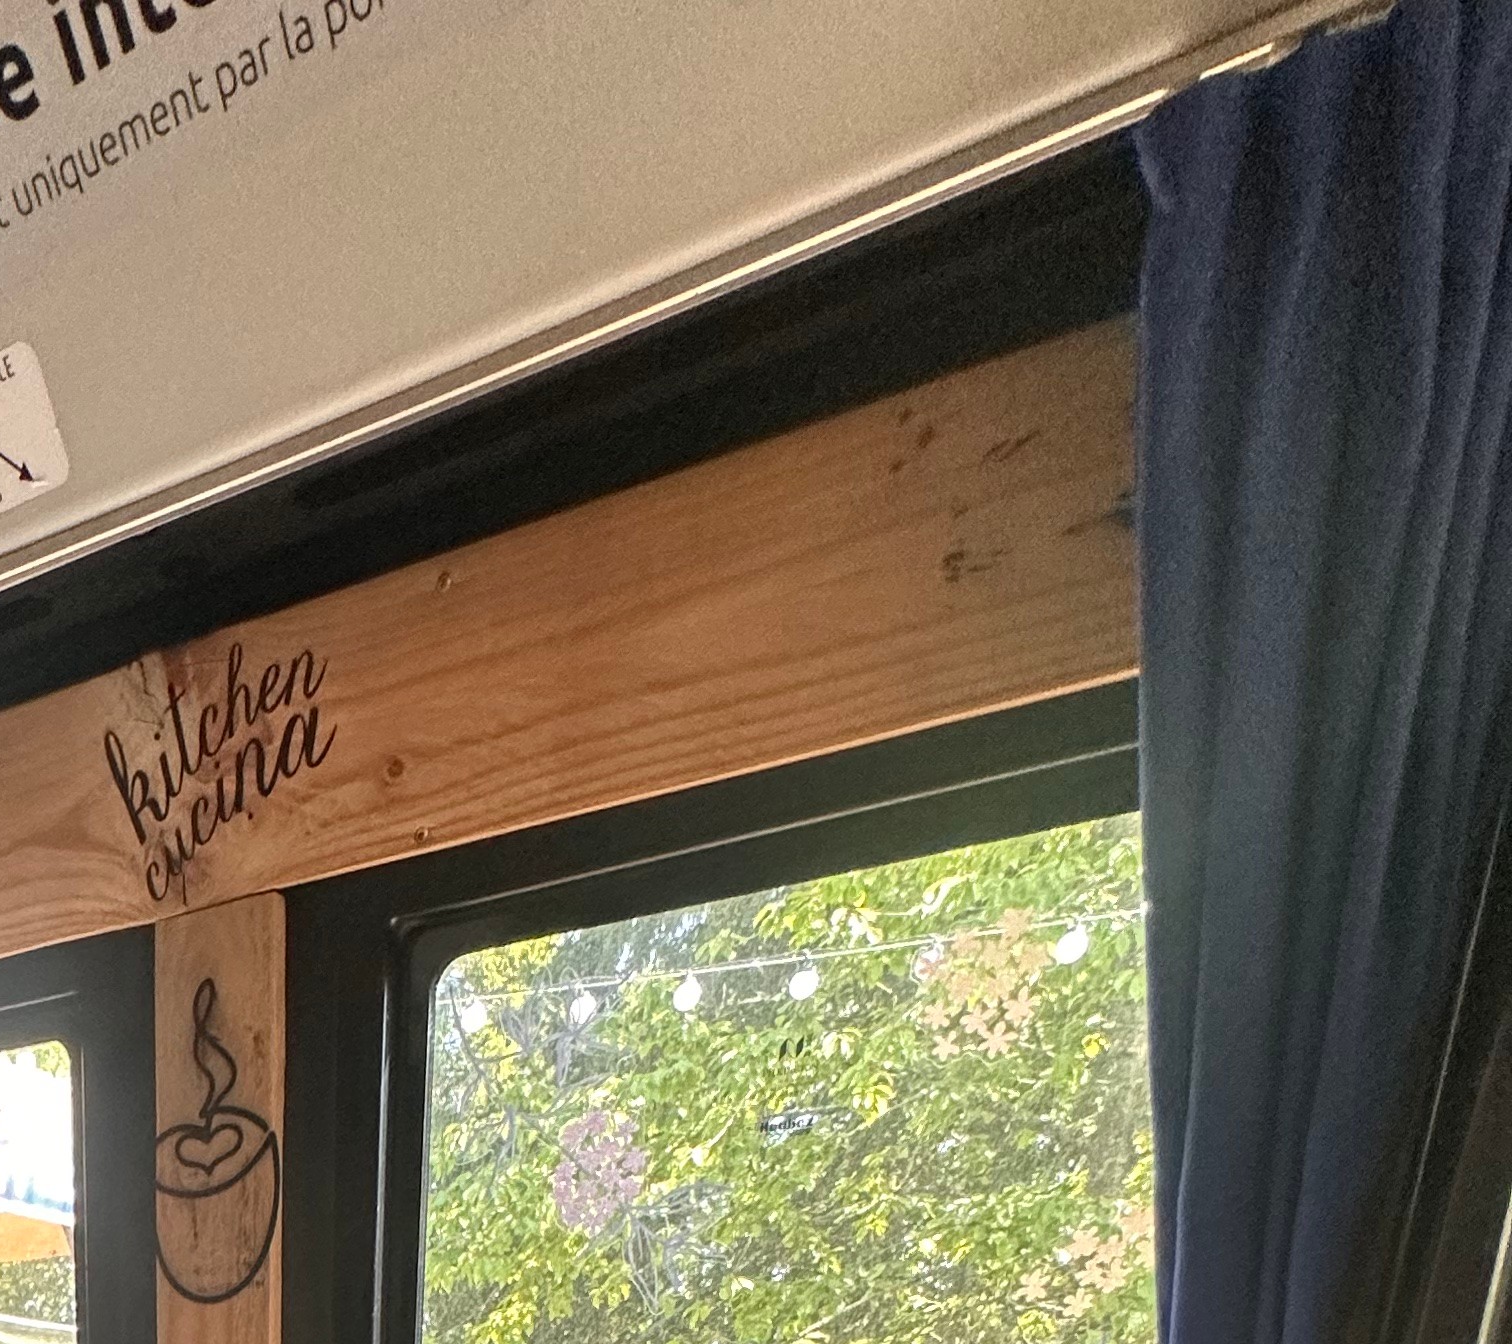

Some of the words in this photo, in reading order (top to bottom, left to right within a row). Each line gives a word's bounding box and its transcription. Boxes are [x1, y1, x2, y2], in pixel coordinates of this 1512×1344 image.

[11, 69, 210, 218] uniquement
[215, 34, 271, 112] par
[278, 10, 315, 61] la
[324, 0, 385, 50] po
[45, 0, 218, 86] in
[103, 642, 329, 846] kitchen
[145, 705, 338, 901] cucina
